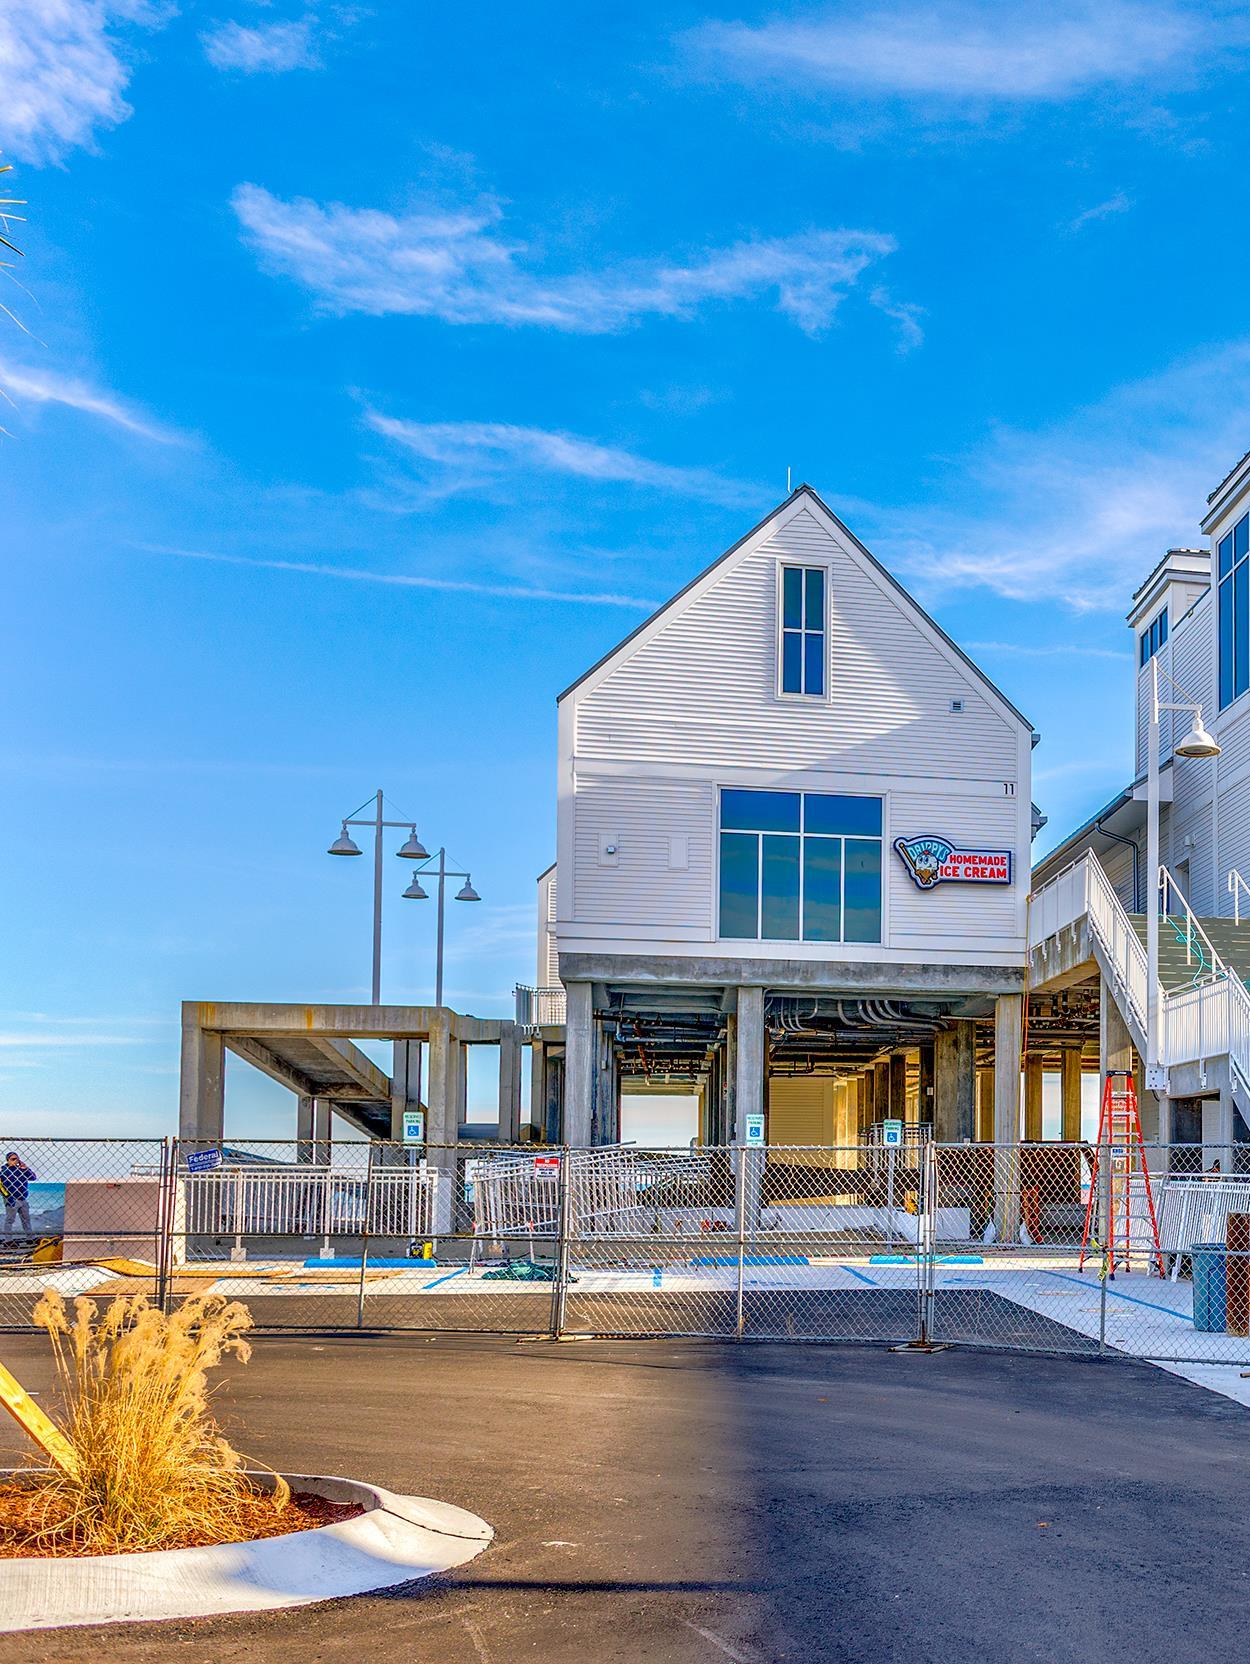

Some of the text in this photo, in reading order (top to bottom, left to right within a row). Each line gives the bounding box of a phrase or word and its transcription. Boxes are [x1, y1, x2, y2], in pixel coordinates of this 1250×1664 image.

[1003, 783, 1014, 795] 11
[949, 854, 1007, 866] HOMEMADE
[940, 865, 1007, 879] ICE CREAM
[188, 1150, 219, 1164] Federal
